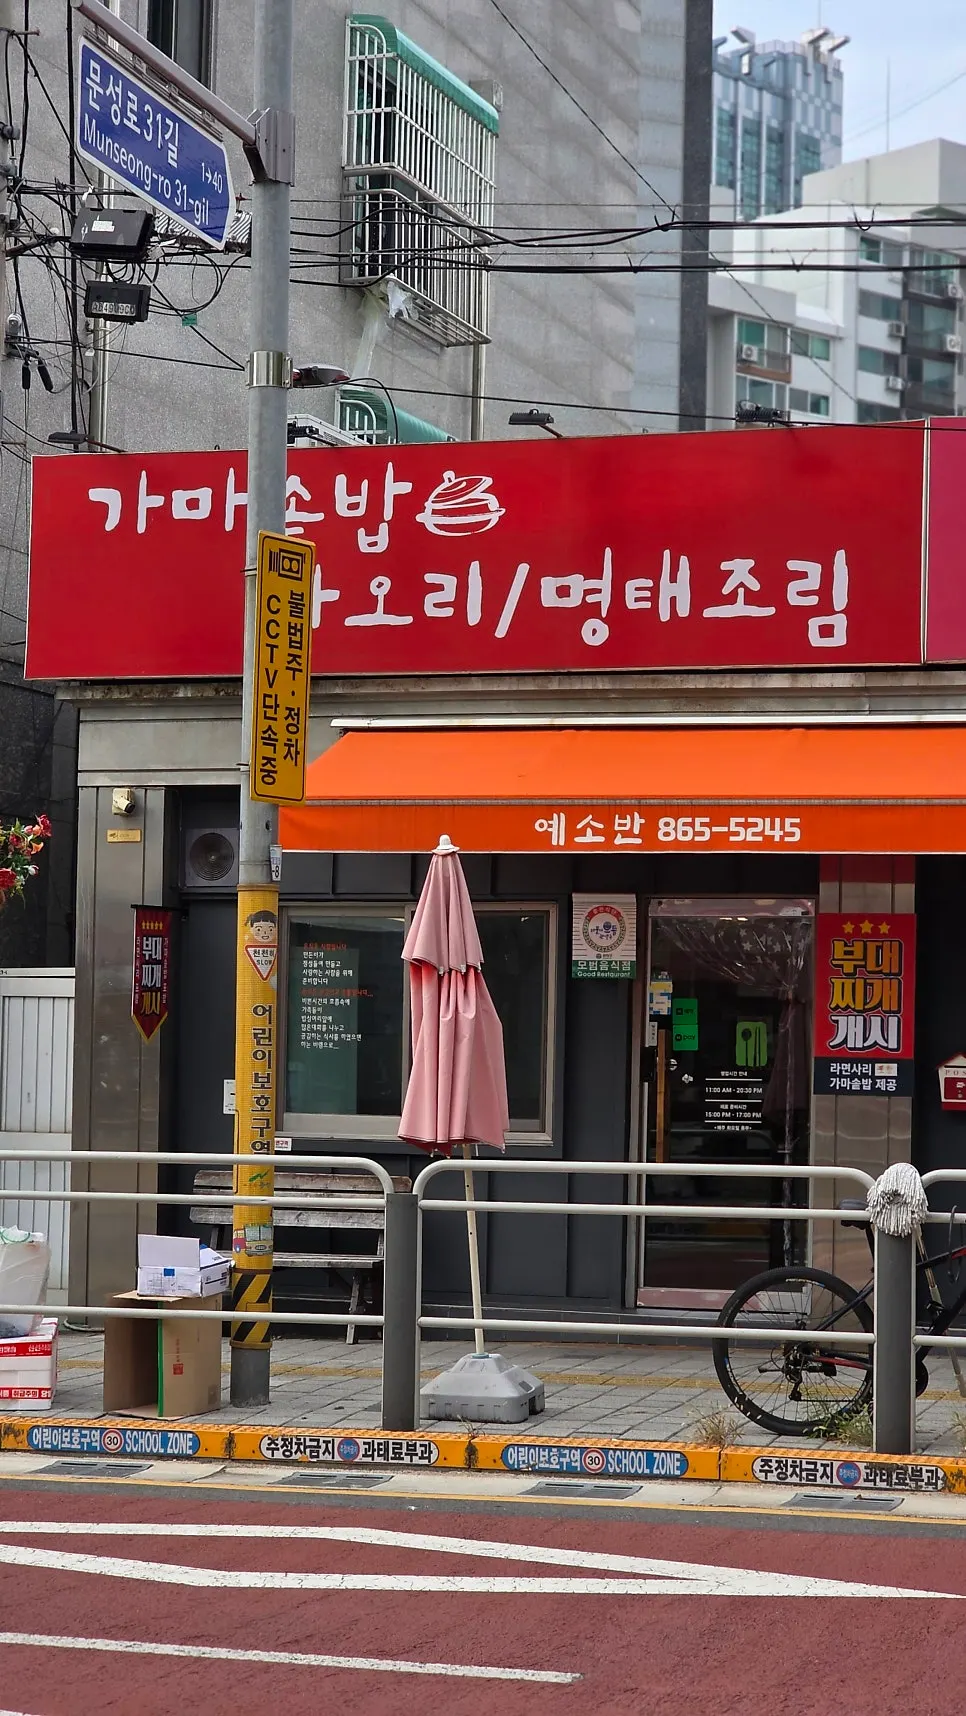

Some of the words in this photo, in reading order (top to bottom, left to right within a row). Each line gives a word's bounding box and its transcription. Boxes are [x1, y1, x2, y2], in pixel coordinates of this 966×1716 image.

[85, 59, 179, 168] 문성로31길
[84, 113, 172, 199] Munseong-ro
[174, 179, 209, 225] 31-gil
[657, 817, 801, 842] 865-5245
[143, 936, 163, 960] 부대
[831, 939, 903, 976] 부대
[141, 964, 162, 988] 찌개
[577, 960, 631, 971] 모범음식점
[140, 991, 161, 1015] 개시
[830, 976, 903, 1014] 찌개
[328, 1024, 345, 1032] 나누고
[829, 1014, 901, 1051] 개시
[250, 1003, 273, 1155] 어린이보호구역
[830, 1062, 872, 1076] 라면사리
[829, 1077, 873, 1091] 가마솥밥
[875, 1078, 898, 1092] 제공
[32, 1427, 100, 1451] 어린이보호구역
[106, 1435, 119, 1446] 30
[125, 1430, 165, 1453] SCHOOL
[167, 1432, 193, 1455] ZONE
[265, 1437, 336, 1460] 주정차금지
[361, 1439, 434, 1464] 과태료부과
[507, 1446, 581, 1471] 어린이보호구역
[587, 1455, 600, 1466] 30
[607, 1450, 650, 1474] SCHOOL
[653, 1452, 681, 1475] ZONE
[758, 1458, 834, 1483] 주정차금지
